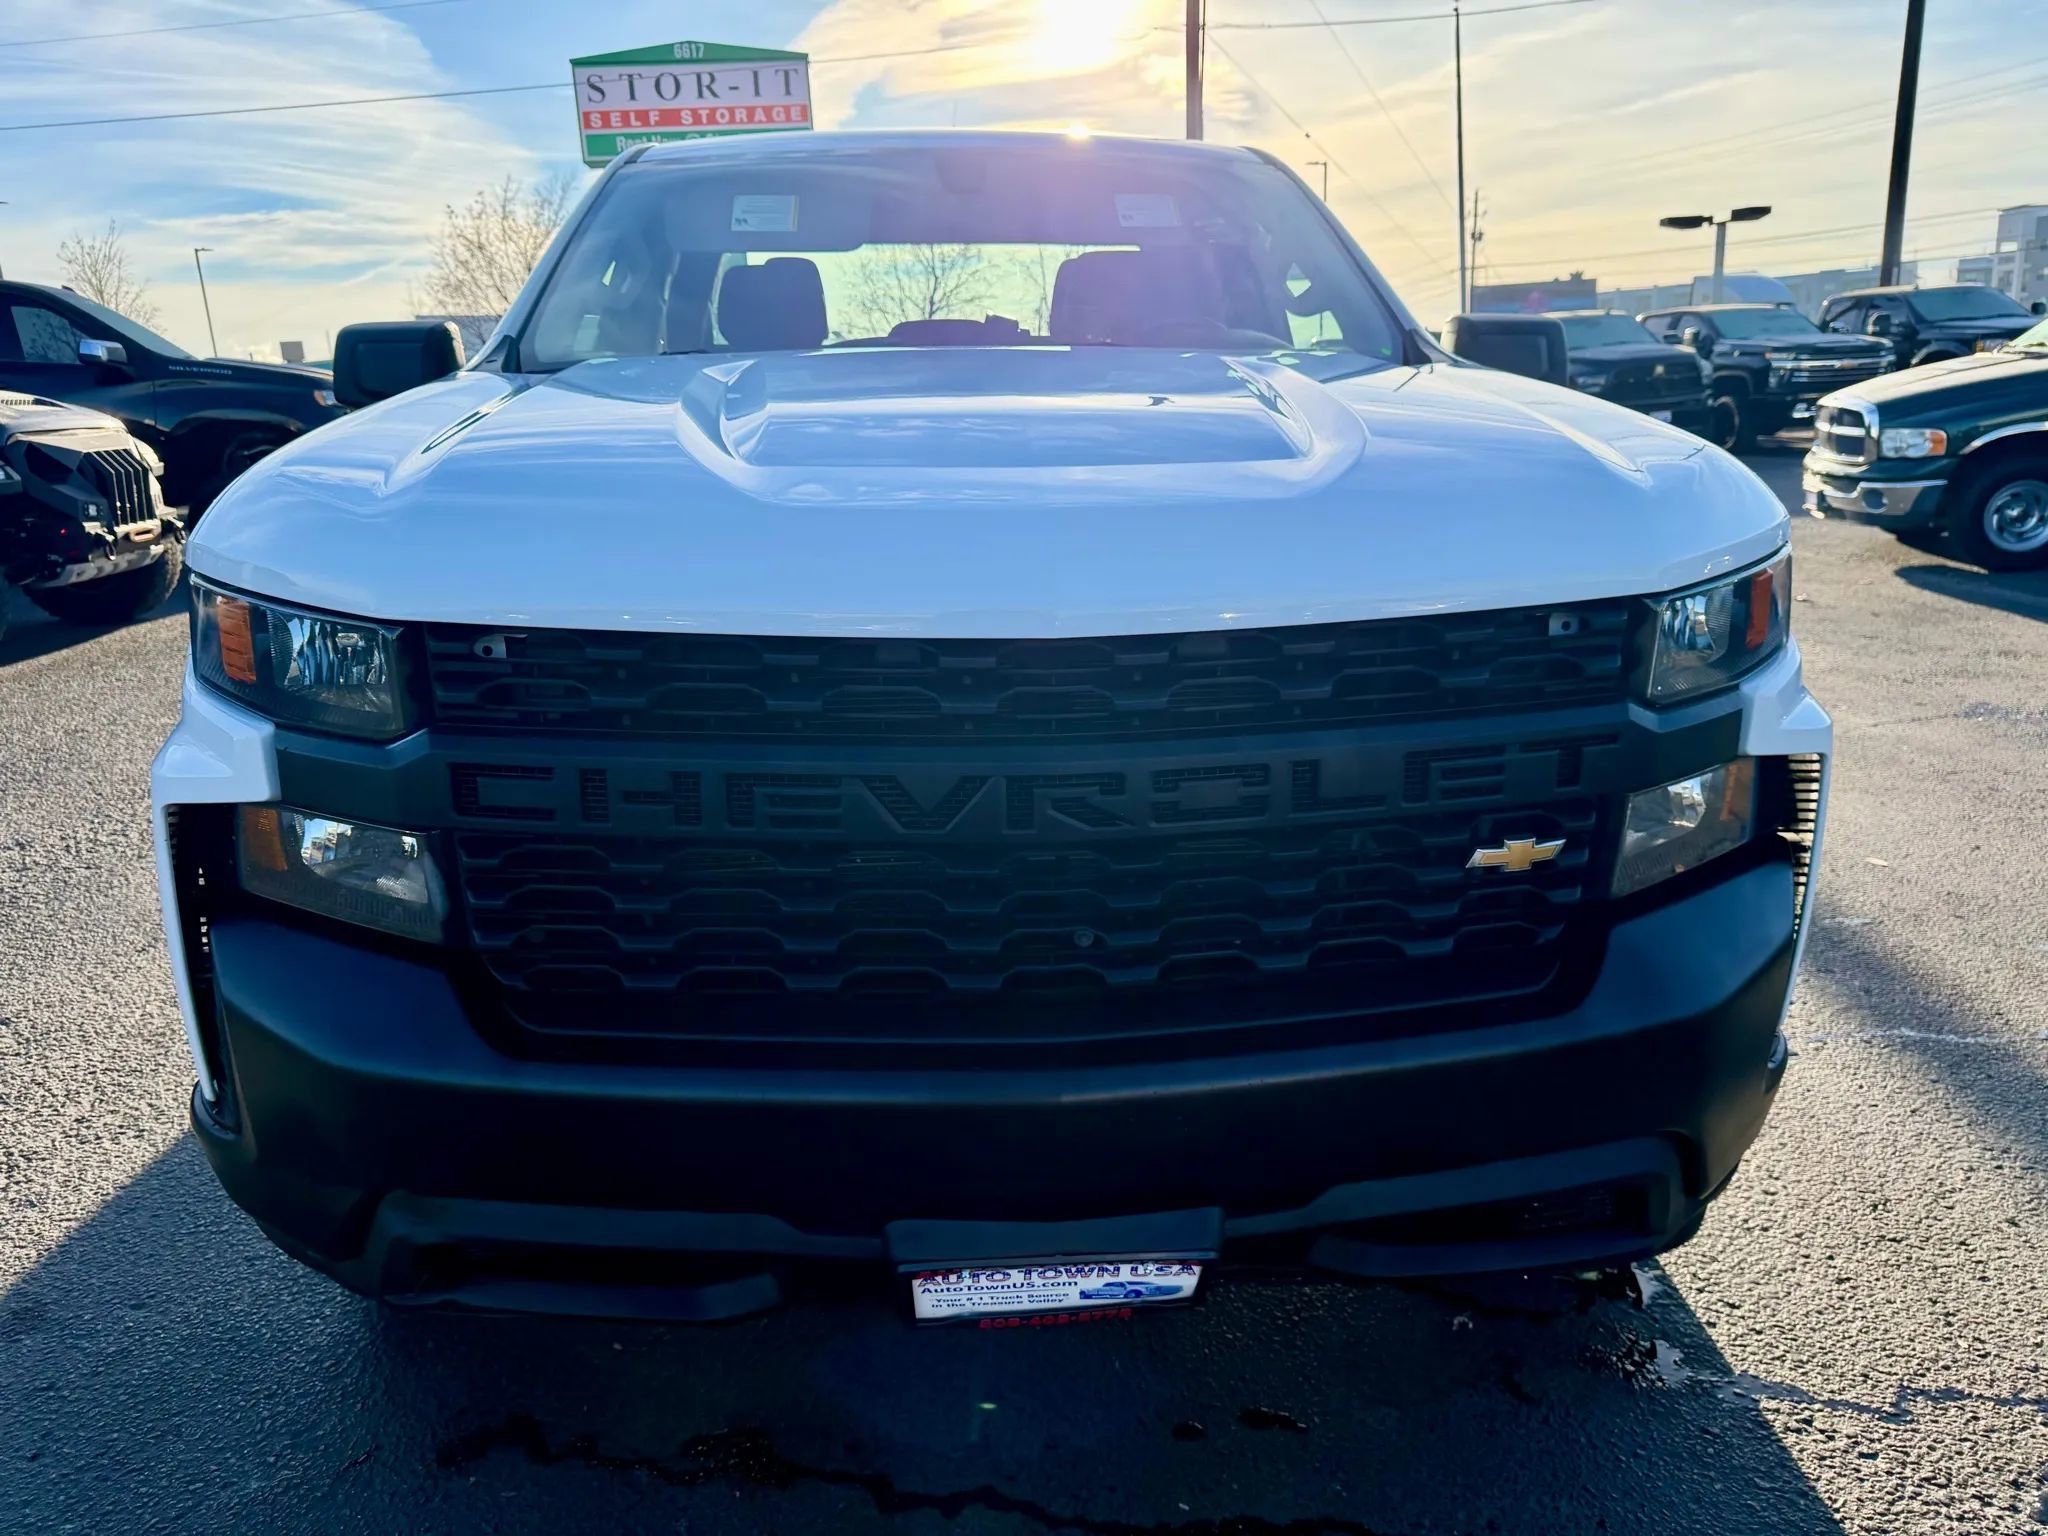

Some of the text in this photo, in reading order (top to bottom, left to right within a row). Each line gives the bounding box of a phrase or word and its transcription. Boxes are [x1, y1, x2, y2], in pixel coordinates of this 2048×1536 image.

[586, 68, 799, 104] STOR-IT
[589, 107, 802, 128] SELF STORAGE
[447, 733, 1621, 834] CHEVROLET
[917, 1260, 1197, 1287] AUTO TOWN USA
[920, 1280, 1079, 1295] AutoTownUS.com
